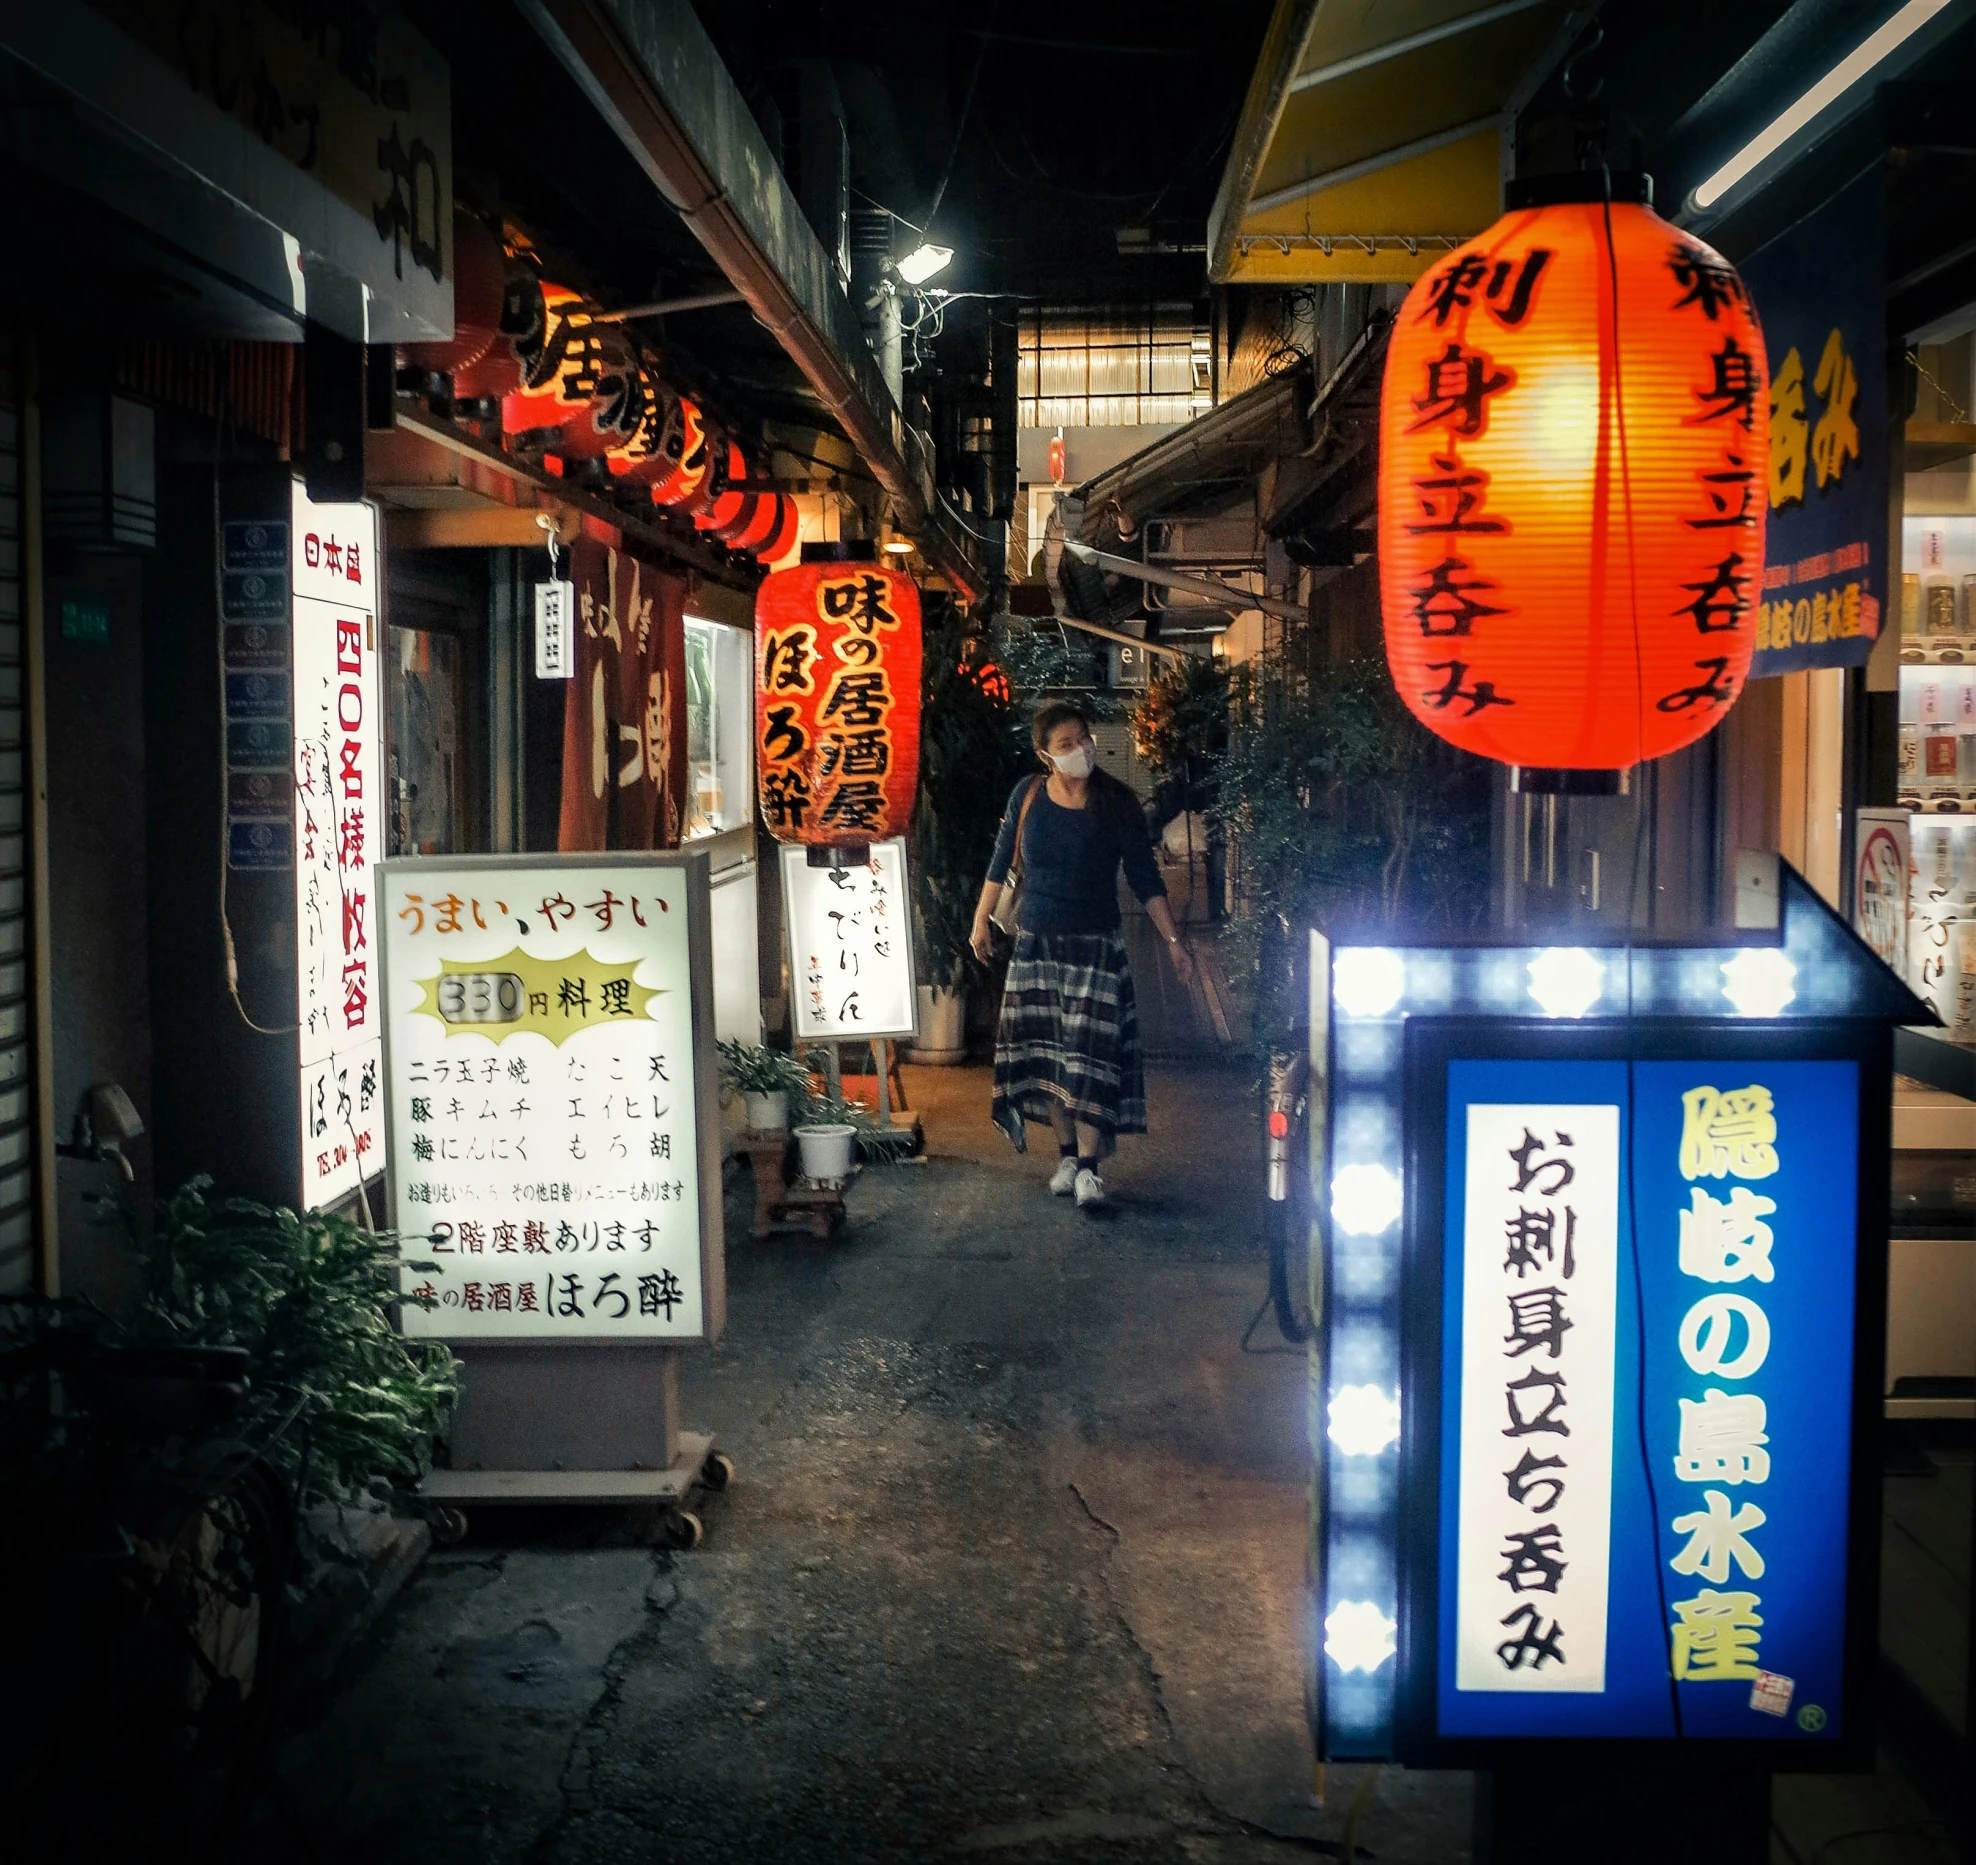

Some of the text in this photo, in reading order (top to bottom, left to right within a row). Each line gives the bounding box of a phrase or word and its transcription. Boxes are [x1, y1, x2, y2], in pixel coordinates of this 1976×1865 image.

[1405, 247, 1555, 719] 刺身立呑み
[763, 629, 813, 829] ほろ酔
[820, 572, 897, 833] 味の居酒屋
[397, 889, 670, 936] うまい、やすい
[409, 1055, 671, 1086] ニラ玉子焼 たこ天
[411, 1094, 670, 1124] 豚キムチ エイヒレ
[411, 1131, 672, 1163] 梅にんにく もろ胡
[430, 1218, 661, 1256] 2階座敷あります
[546, 1266, 686, 1323] ほろ酔
[1496, 1126, 1577, 1674] お刺身立ち呑み
[1668, 1082, 1781, 1684] 隠岐の島水産
